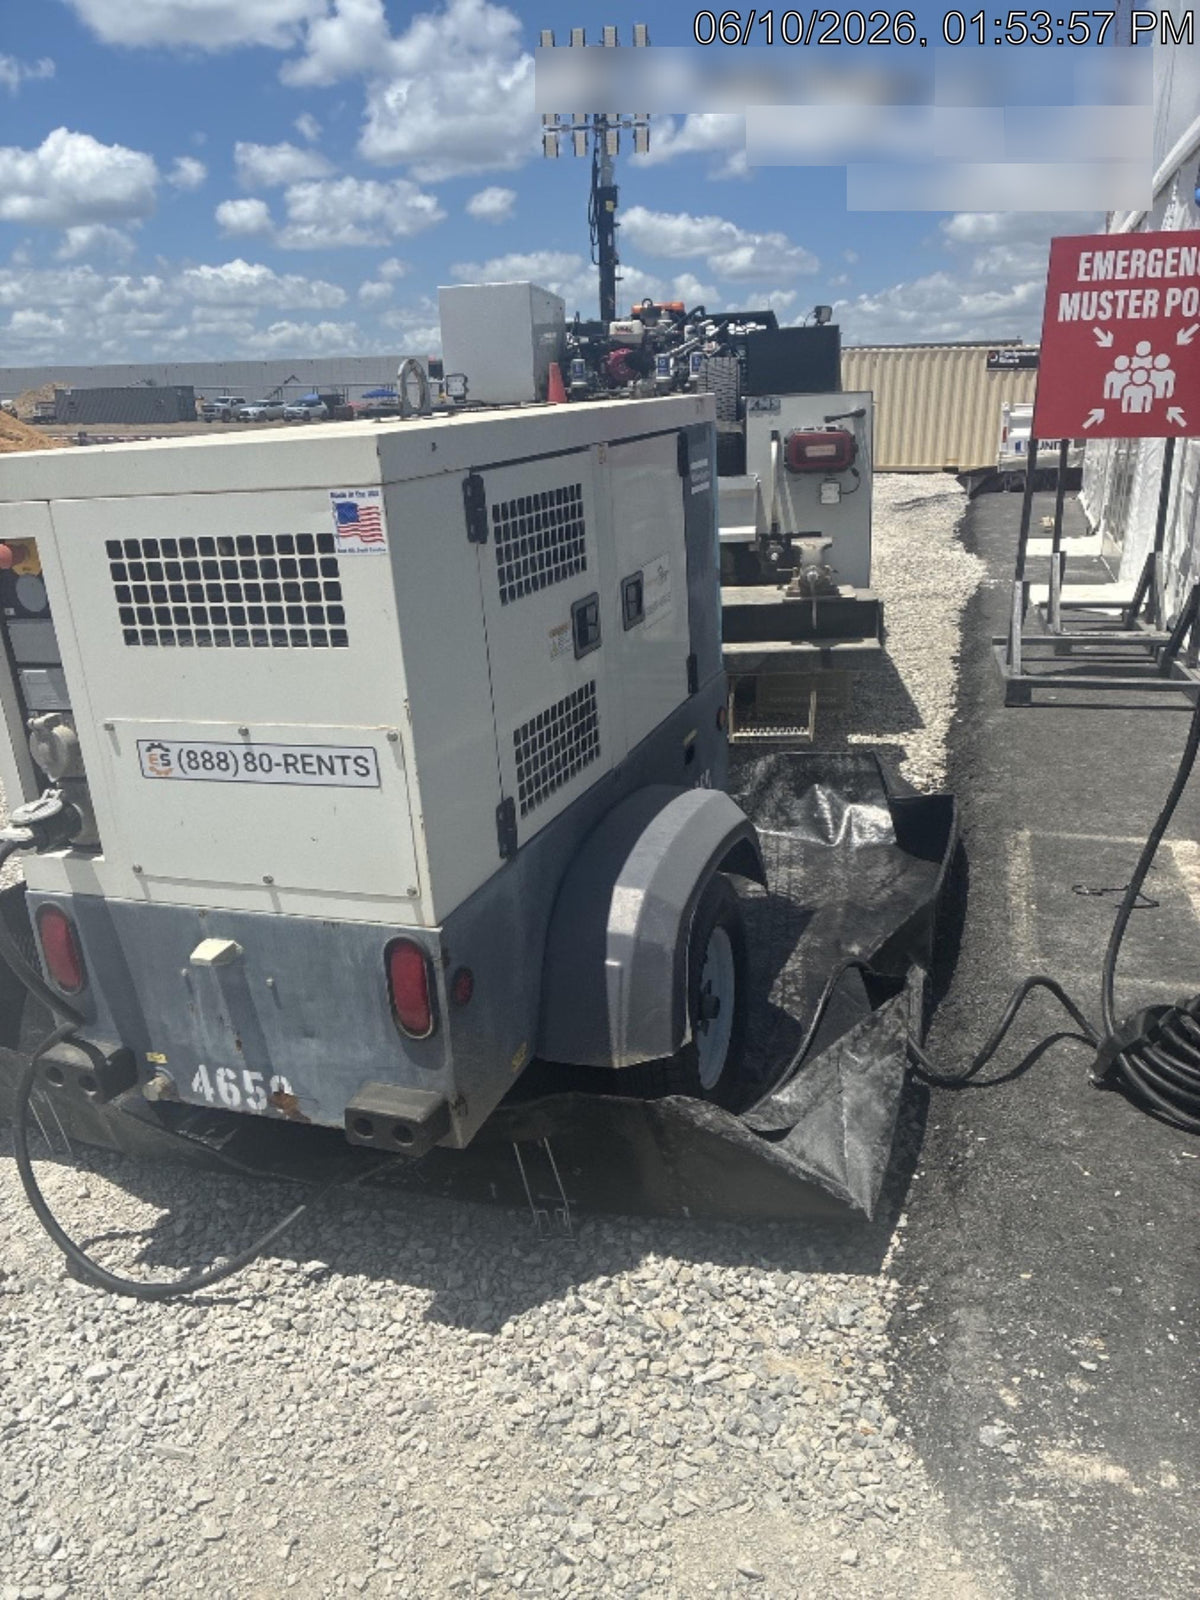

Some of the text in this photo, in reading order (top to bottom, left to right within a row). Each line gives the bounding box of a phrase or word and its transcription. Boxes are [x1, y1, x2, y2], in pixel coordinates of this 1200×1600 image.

[1077, 247, 1200, 282] EMERGEN
[1057, 286, 1200, 323] MUSTER PO
[177, 748, 239, 777] (888)
[243, 751, 370, 777] 80-RENTS
